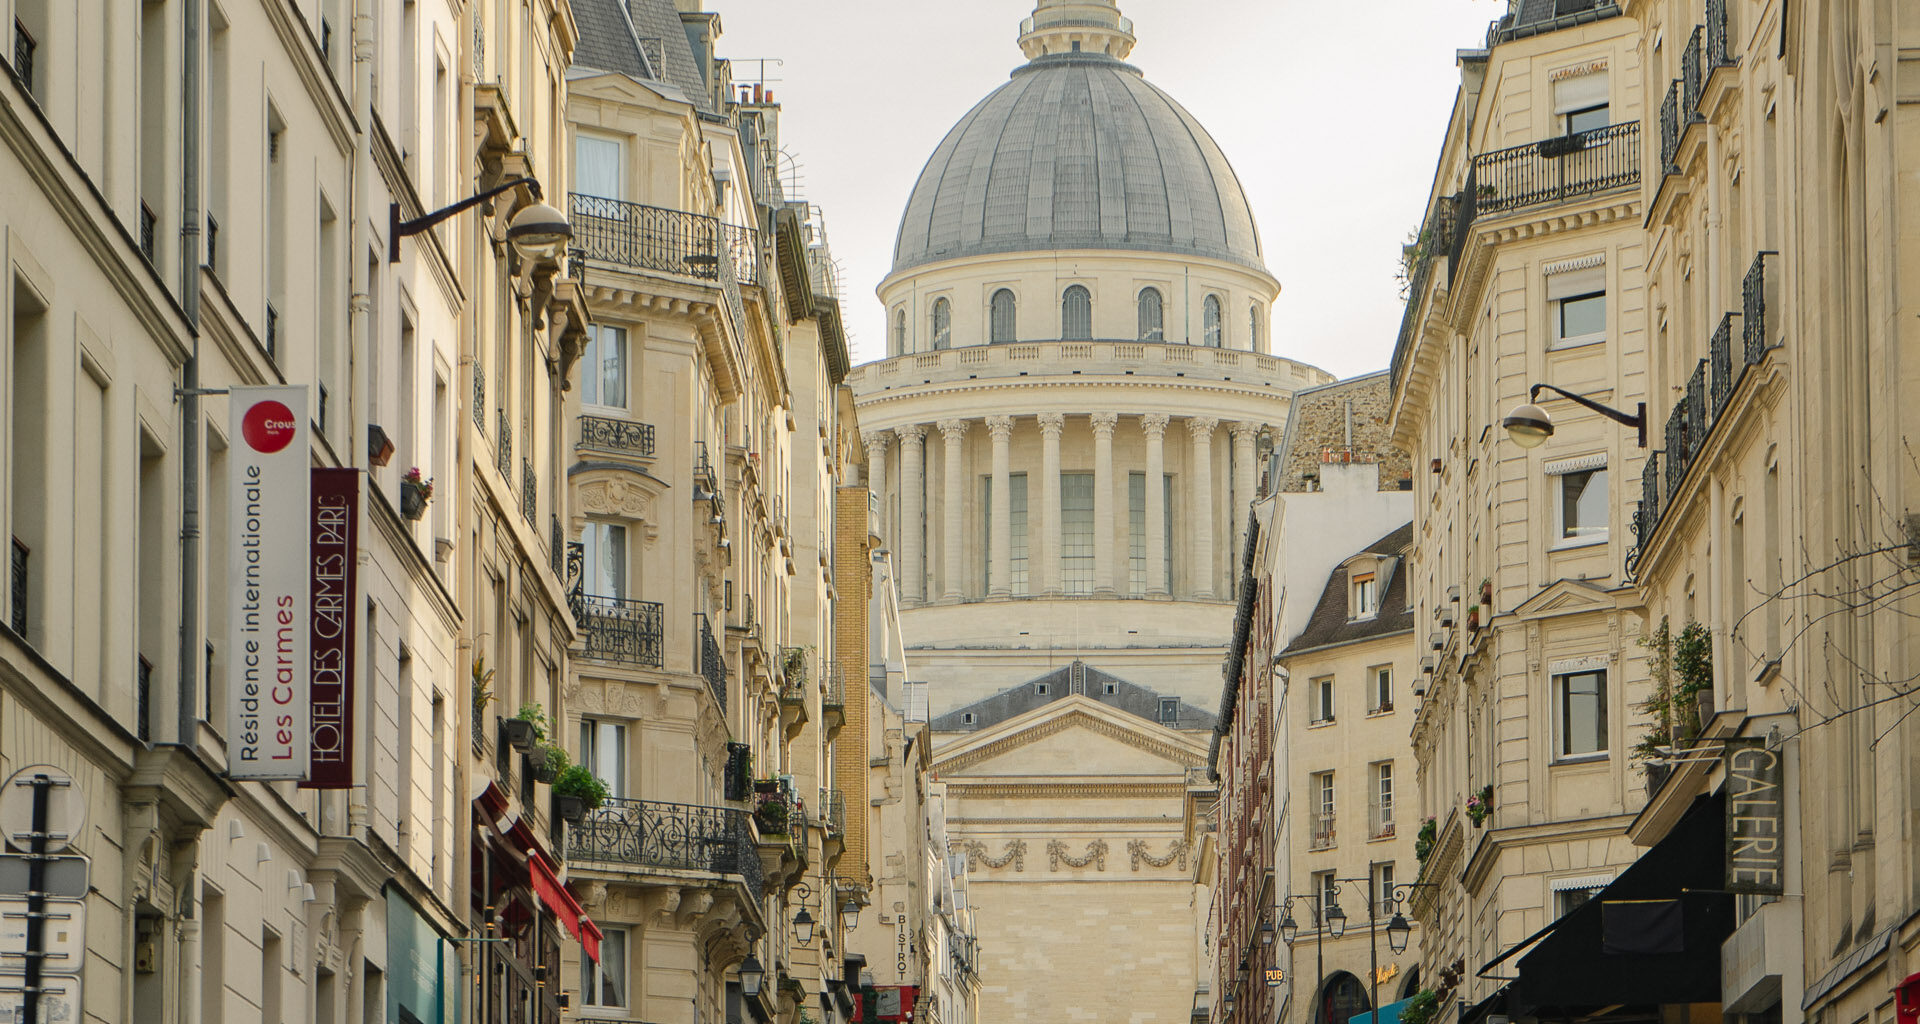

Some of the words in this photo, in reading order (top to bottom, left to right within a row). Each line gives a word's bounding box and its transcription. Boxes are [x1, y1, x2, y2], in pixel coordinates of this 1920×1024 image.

[264, 419, 296, 429] Crous
[241, 465, 260, 632] internationale
[315, 554, 344, 638] CARMES
[272, 595, 293, 704] Carmes
[313, 648, 342, 685] DES
[240, 640, 259, 761] Résidence
[272, 715, 293, 760] Les
[1730, 747, 1778, 885] GALERIE
[897, 914, 907, 981] BISTROT
[1265, 969, 1284, 981] PUB
